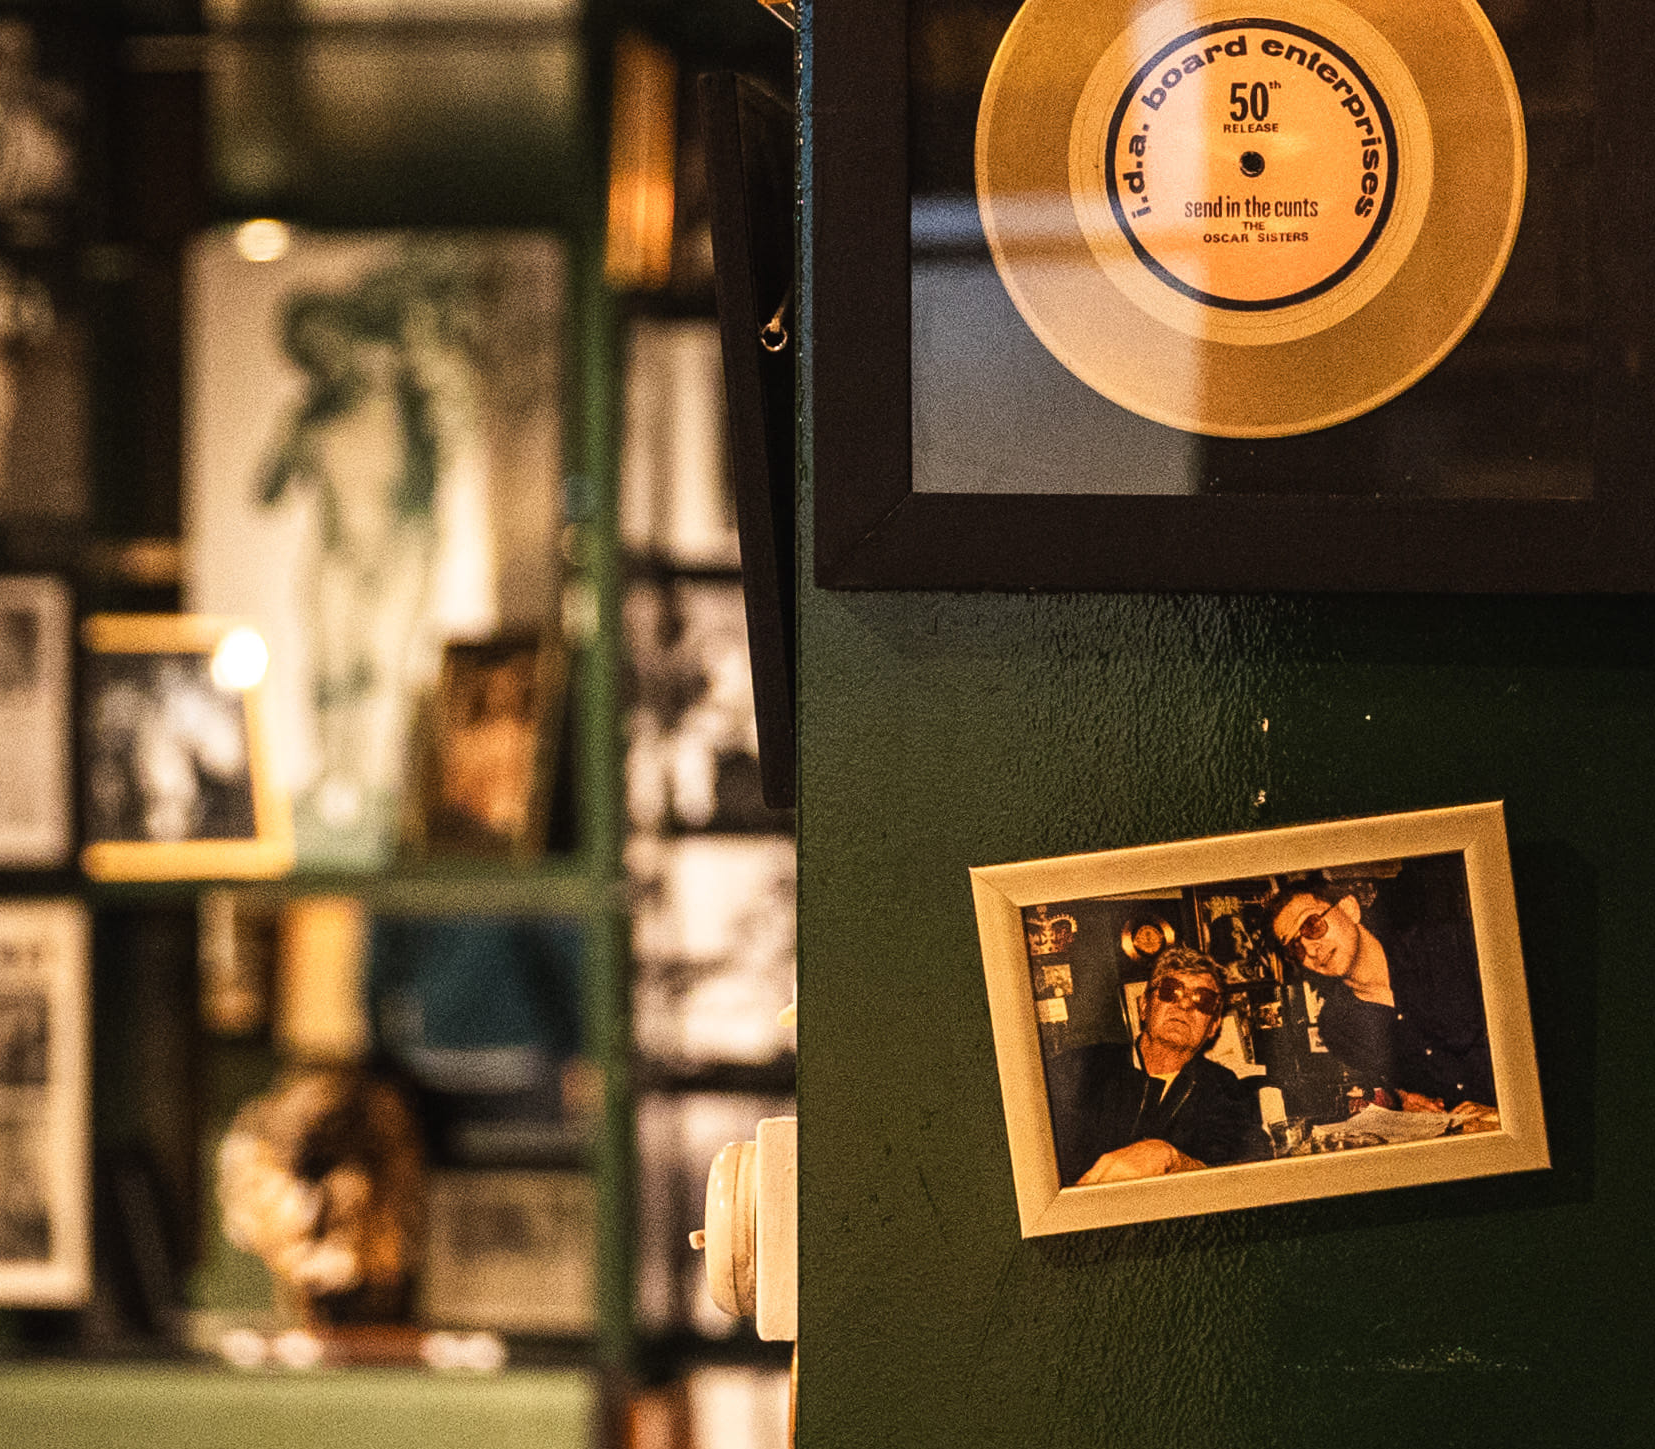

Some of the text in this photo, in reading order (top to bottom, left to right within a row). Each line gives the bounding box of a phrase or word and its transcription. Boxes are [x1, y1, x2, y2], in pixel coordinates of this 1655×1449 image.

[1122, 35, 1382, 219] i.d.a. board enterprises
[1223, 122, 1279, 134] RELEASE
[1184, 195, 1319, 218] send in the cunts
[1241, 220, 1266, 231] THE
[1202, 231, 1310, 244] OSCAR SISTERS
